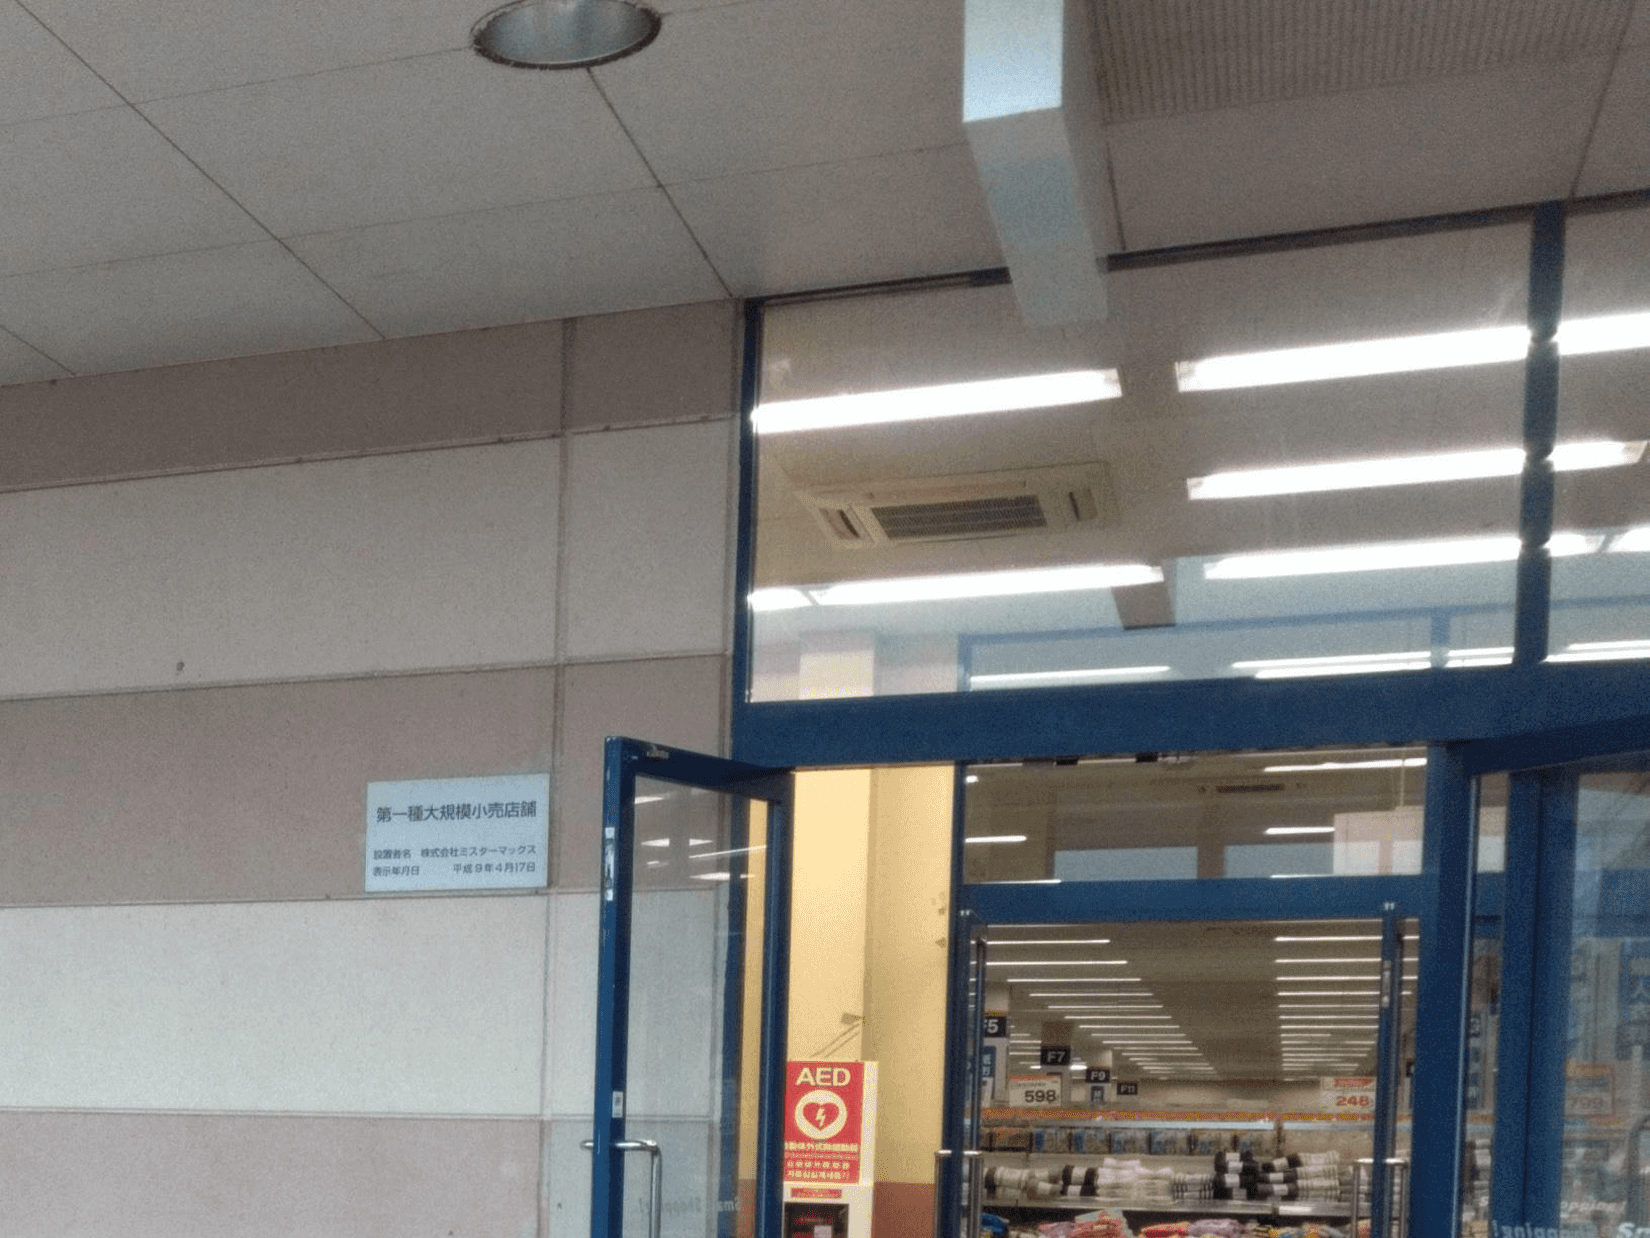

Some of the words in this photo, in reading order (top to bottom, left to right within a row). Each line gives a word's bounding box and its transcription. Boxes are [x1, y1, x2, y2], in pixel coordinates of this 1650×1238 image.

[376, 801, 537, 823] 第一種大規模小売店舗
[420, 845, 537, 858] 株式会社ミスターマックス
[373, 865, 420, 877] 表示年月日
[1046, 1051, 1065, 1063] F7
[795, 1067, 851, 1086] AED
[1024, 1089, 1057, 1103] 598
[1336, 1095, 1370, 1107] 248
